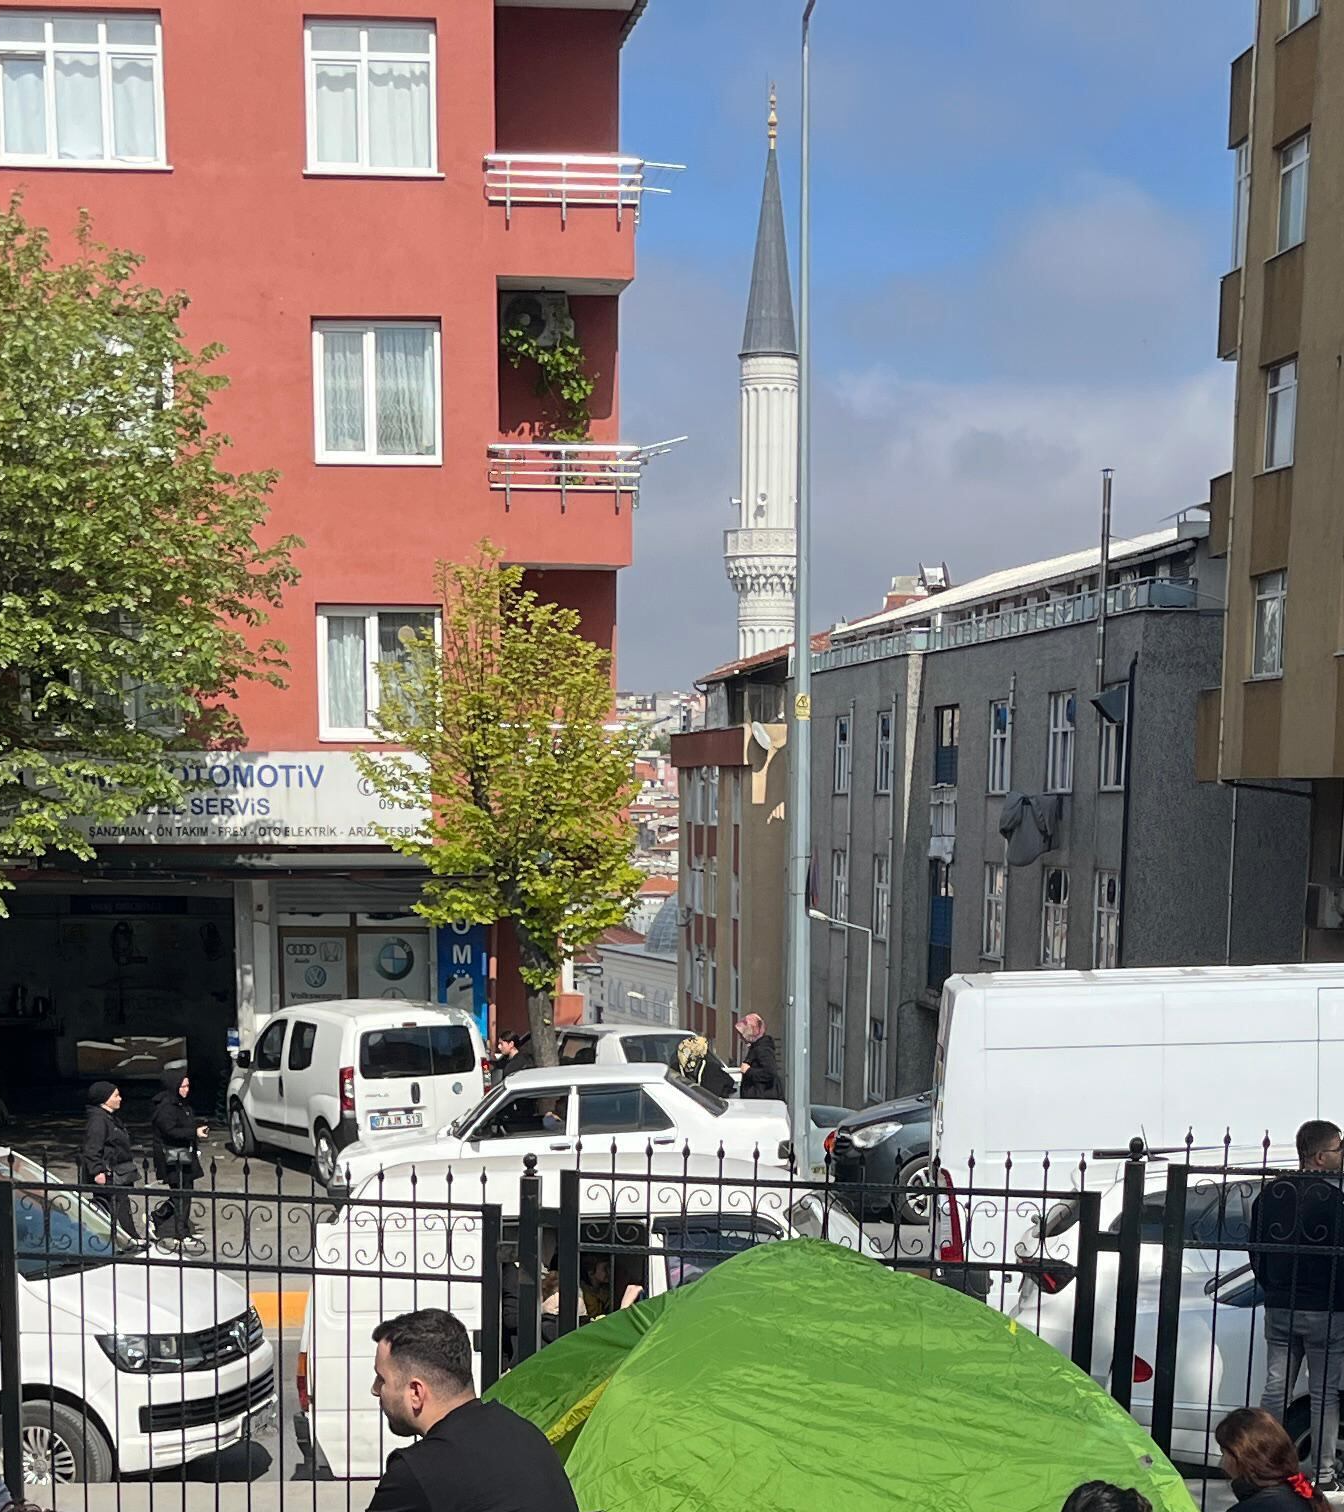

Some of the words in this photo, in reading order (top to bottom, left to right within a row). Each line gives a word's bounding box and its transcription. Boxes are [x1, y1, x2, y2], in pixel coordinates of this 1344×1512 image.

[190, 797, 271, 816] SERViS
[89, 826, 145, 838] ŞANZIMAN
[157, 824, 173, 837] ÖN
[176, 826, 209, 837] TAKIM
[218, 826, 247, 837] FREN
[258, 826, 282, 837] OTO
[283, 824, 337, 837] ELEKTRİK
